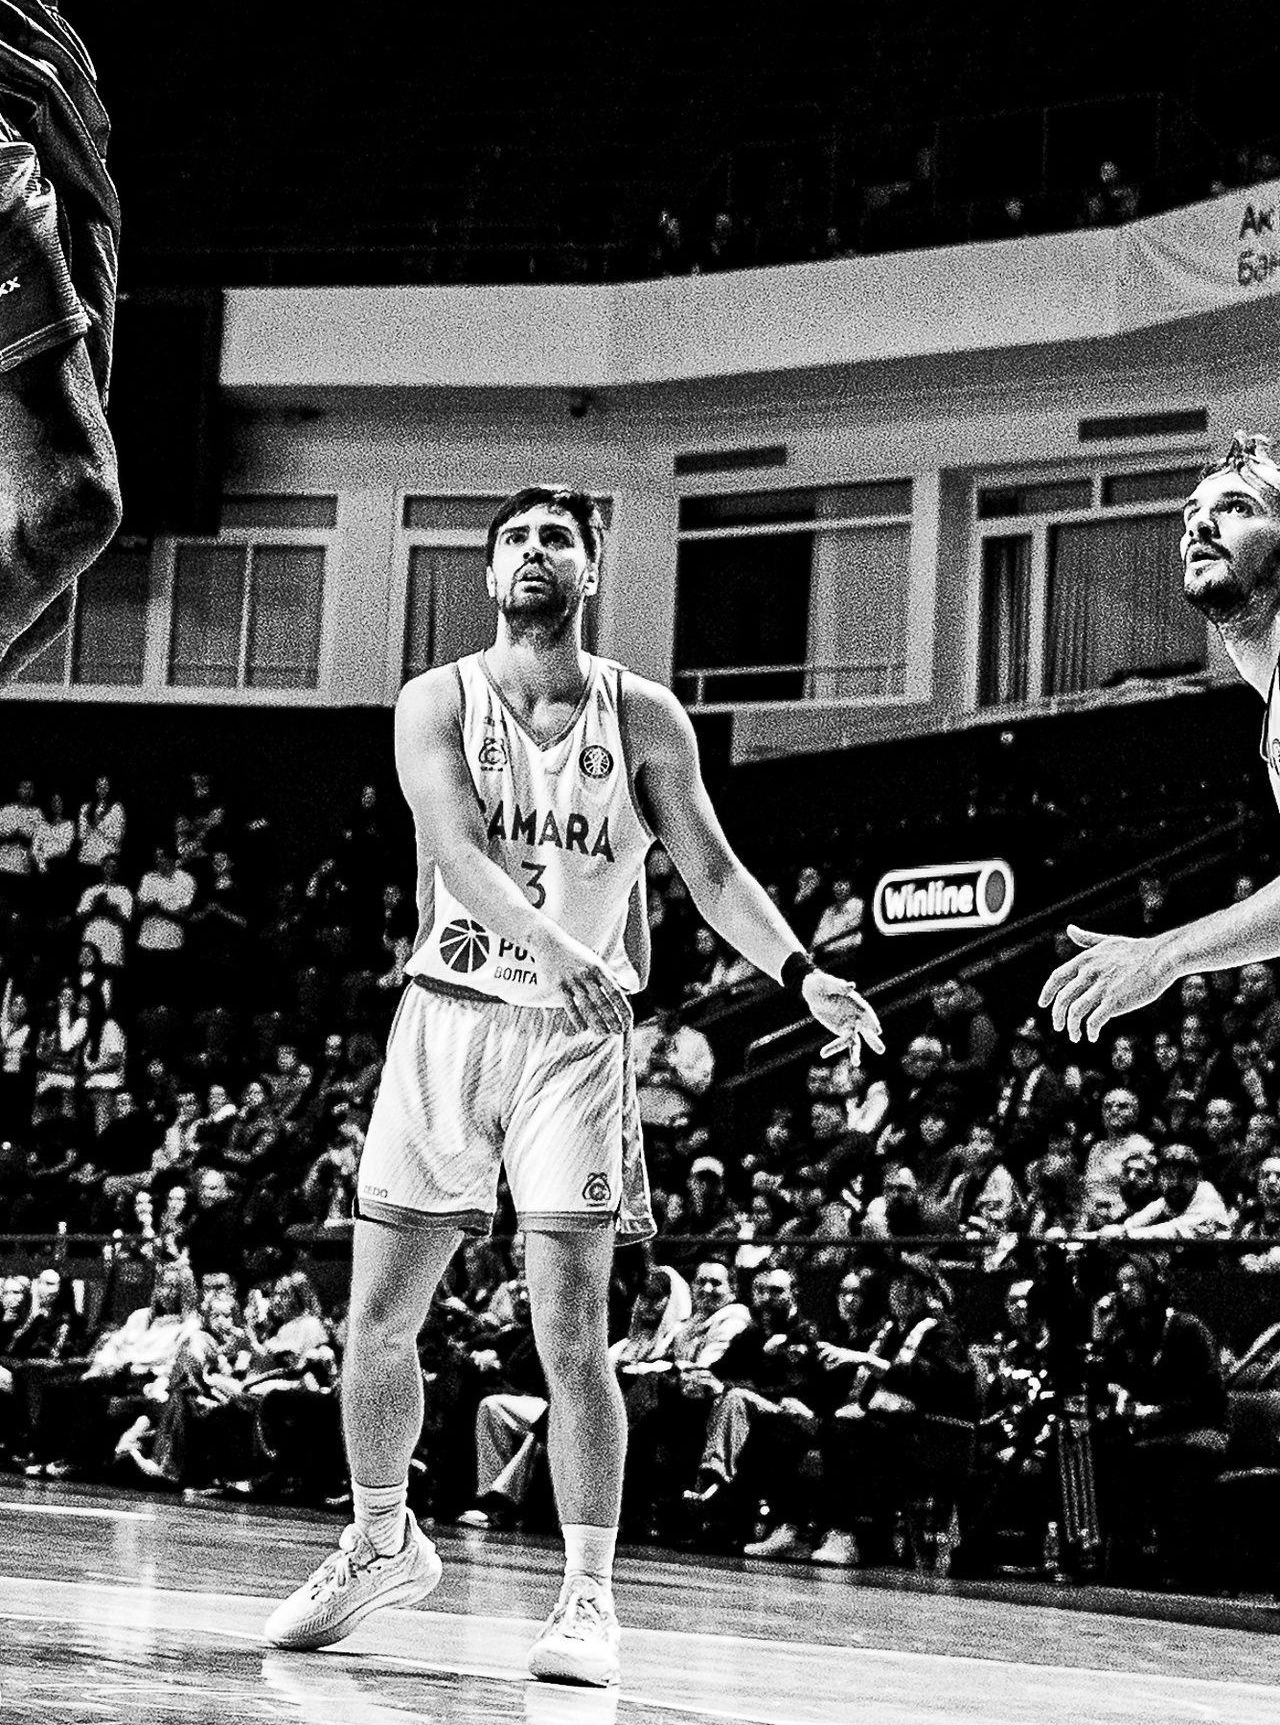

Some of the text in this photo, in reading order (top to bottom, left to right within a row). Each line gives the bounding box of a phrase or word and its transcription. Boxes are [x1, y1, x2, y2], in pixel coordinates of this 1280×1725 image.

[474, 794, 615, 863] AMARA
[521, 860, 546, 909] 3
[885, 880, 973, 919] Winline
[494, 966, 538, 985] ВОЛГА
